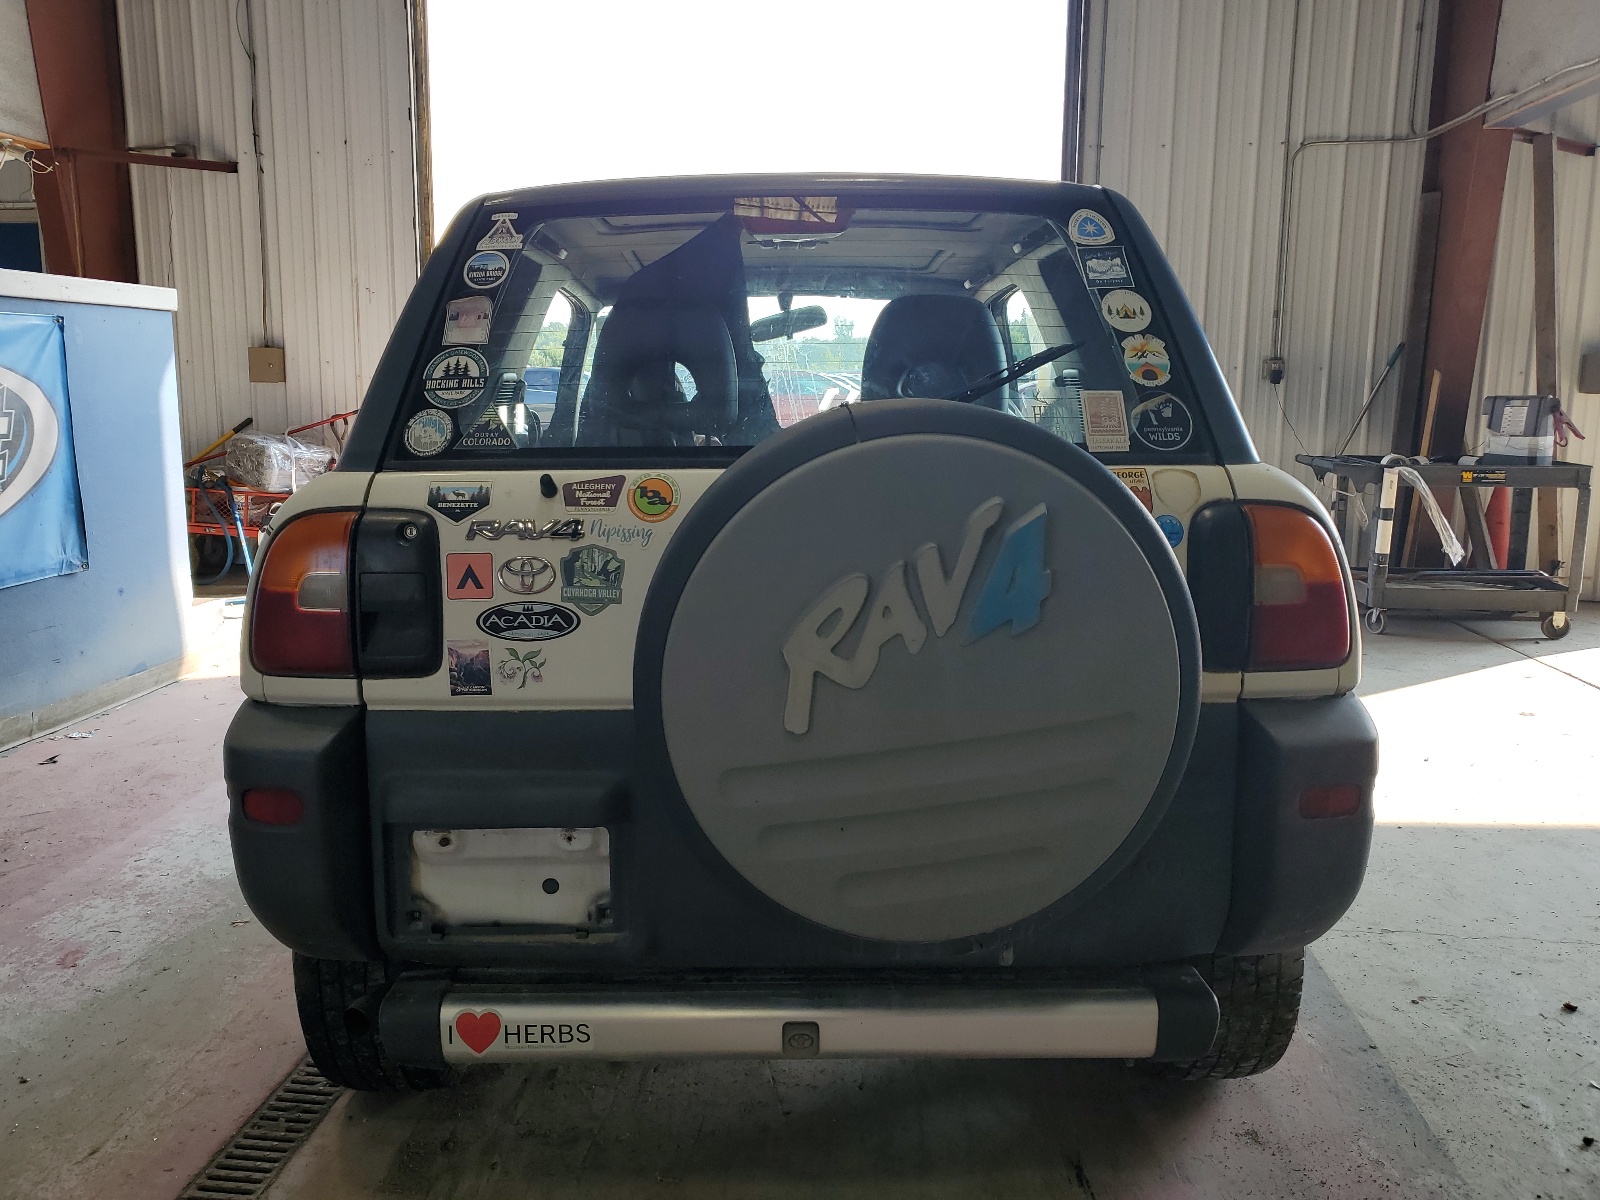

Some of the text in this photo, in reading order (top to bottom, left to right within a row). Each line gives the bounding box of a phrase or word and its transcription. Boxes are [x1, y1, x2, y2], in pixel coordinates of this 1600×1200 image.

[425, 378, 485, 390] HOCKING HILLS
[462, 437, 511, 446] COLORADO
[1148, 432, 1181, 441] WILDS
[575, 490, 611, 498] National
[580, 498, 606, 506] Forest
[465, 518, 585, 541] RAV4
[590, 518, 654, 548] Nipissing
[563, 587, 621, 598] CUYAHOGA VALLEY
[485, 613, 569, 629] ACADIA
[780, 496, 1051, 735] RAV4
[448, 1023, 592, 1045] I HERBS
